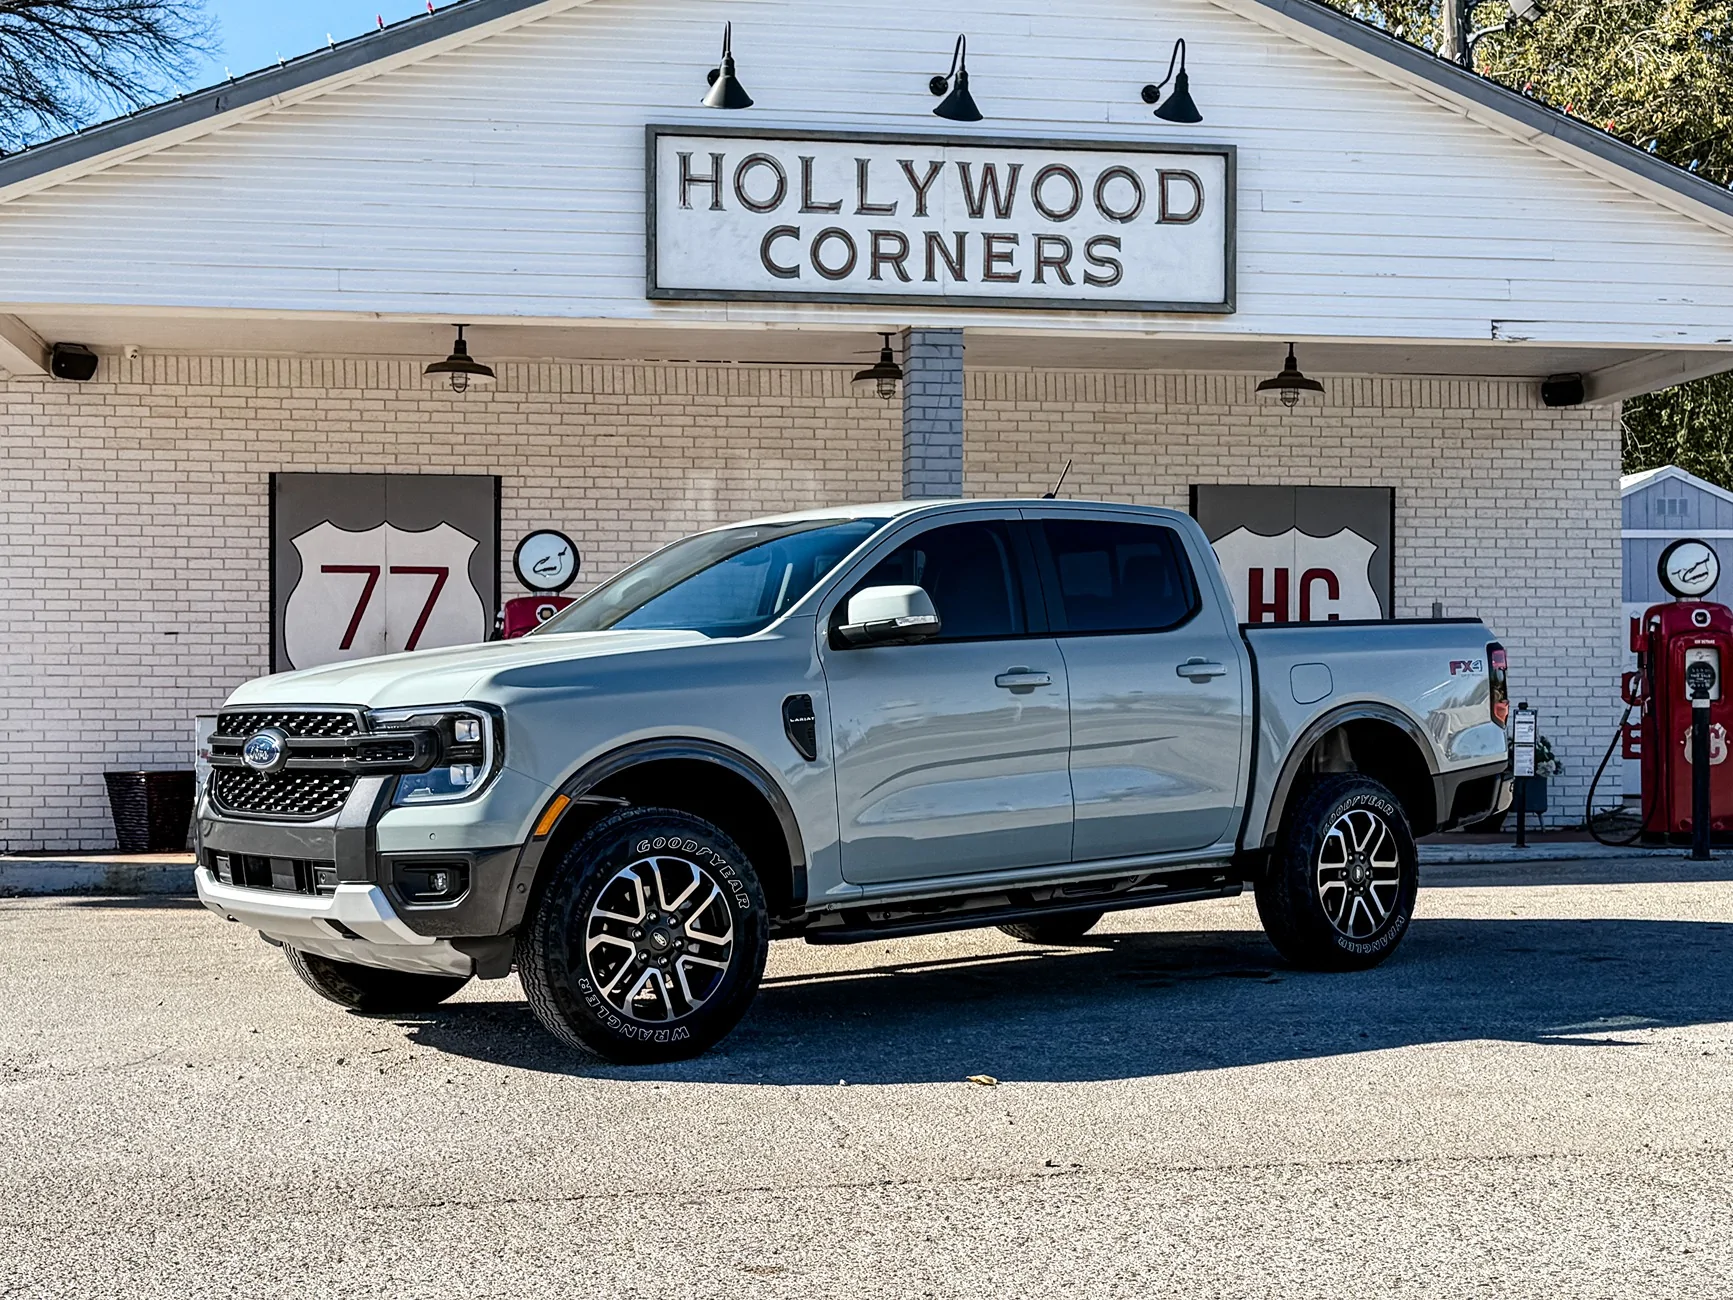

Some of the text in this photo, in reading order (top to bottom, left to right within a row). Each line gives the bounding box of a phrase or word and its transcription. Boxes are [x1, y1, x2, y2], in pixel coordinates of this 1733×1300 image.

[676, 151, 1205, 225] HOLLYWOOD
[760, 225, 1123, 288] CORNERS
[321, 565, 449, 651] 77
[1248, 567, 1340, 623] HC
[1449, 660, 1482, 675] FX4
[636, 836, 750, 909] GOODYEAR
[578, 977, 690, 1042] WRANGLER
